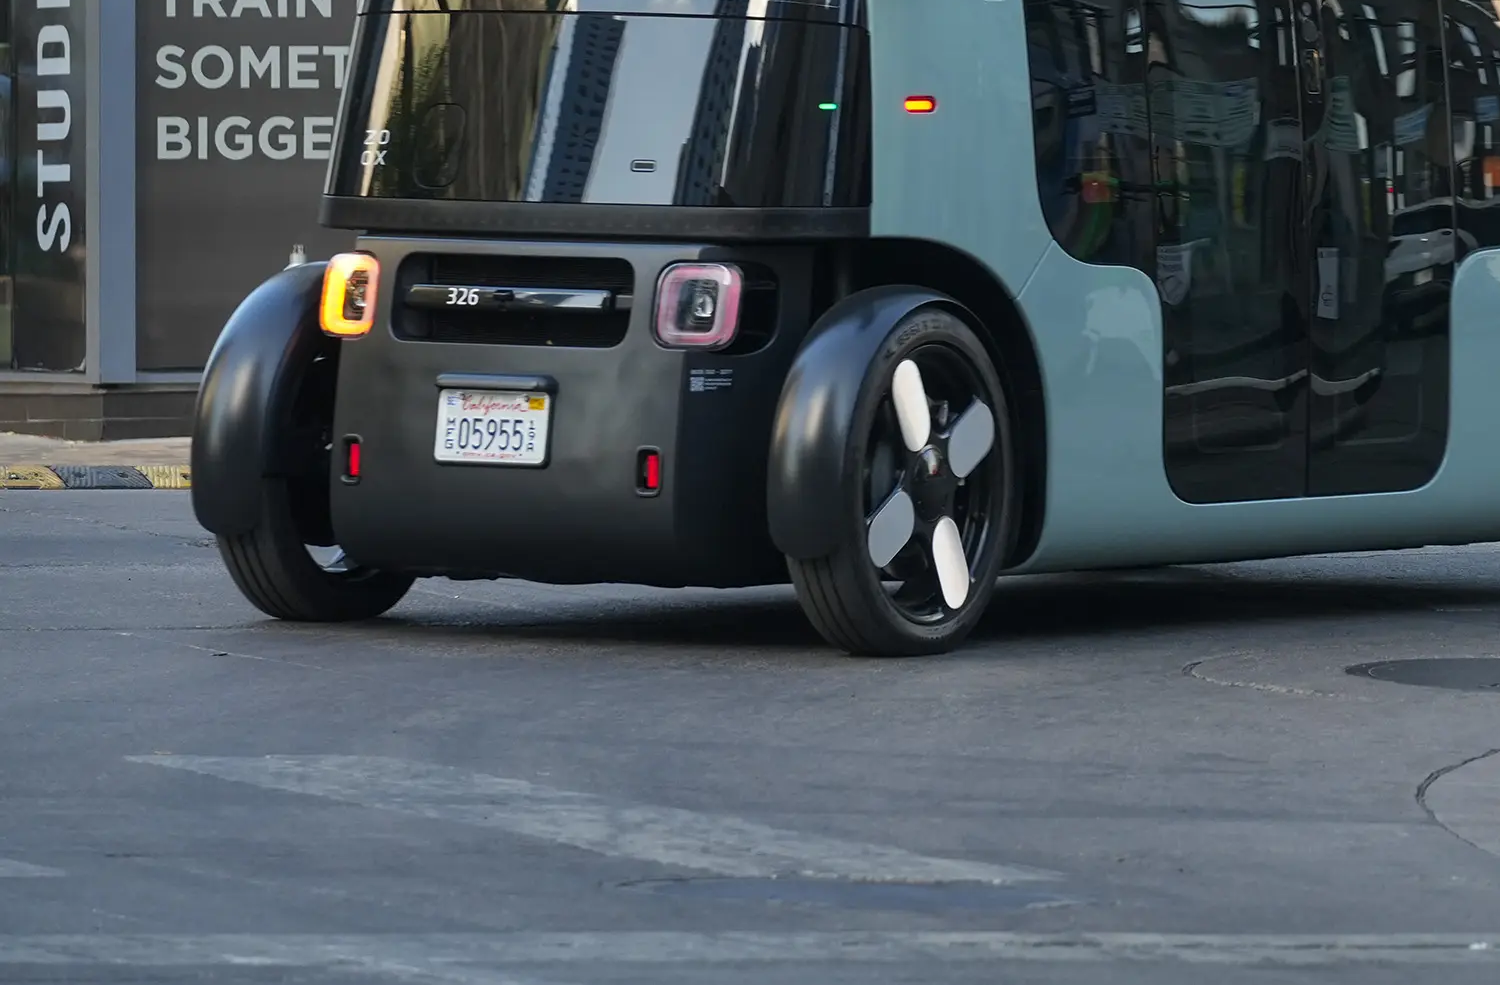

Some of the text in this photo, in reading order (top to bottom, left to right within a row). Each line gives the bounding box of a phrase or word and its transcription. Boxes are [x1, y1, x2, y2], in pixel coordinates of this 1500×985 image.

[446, 287, 480, 306] 326
[462, 395, 528, 416] California
[457, 418, 524, 451] 05955
